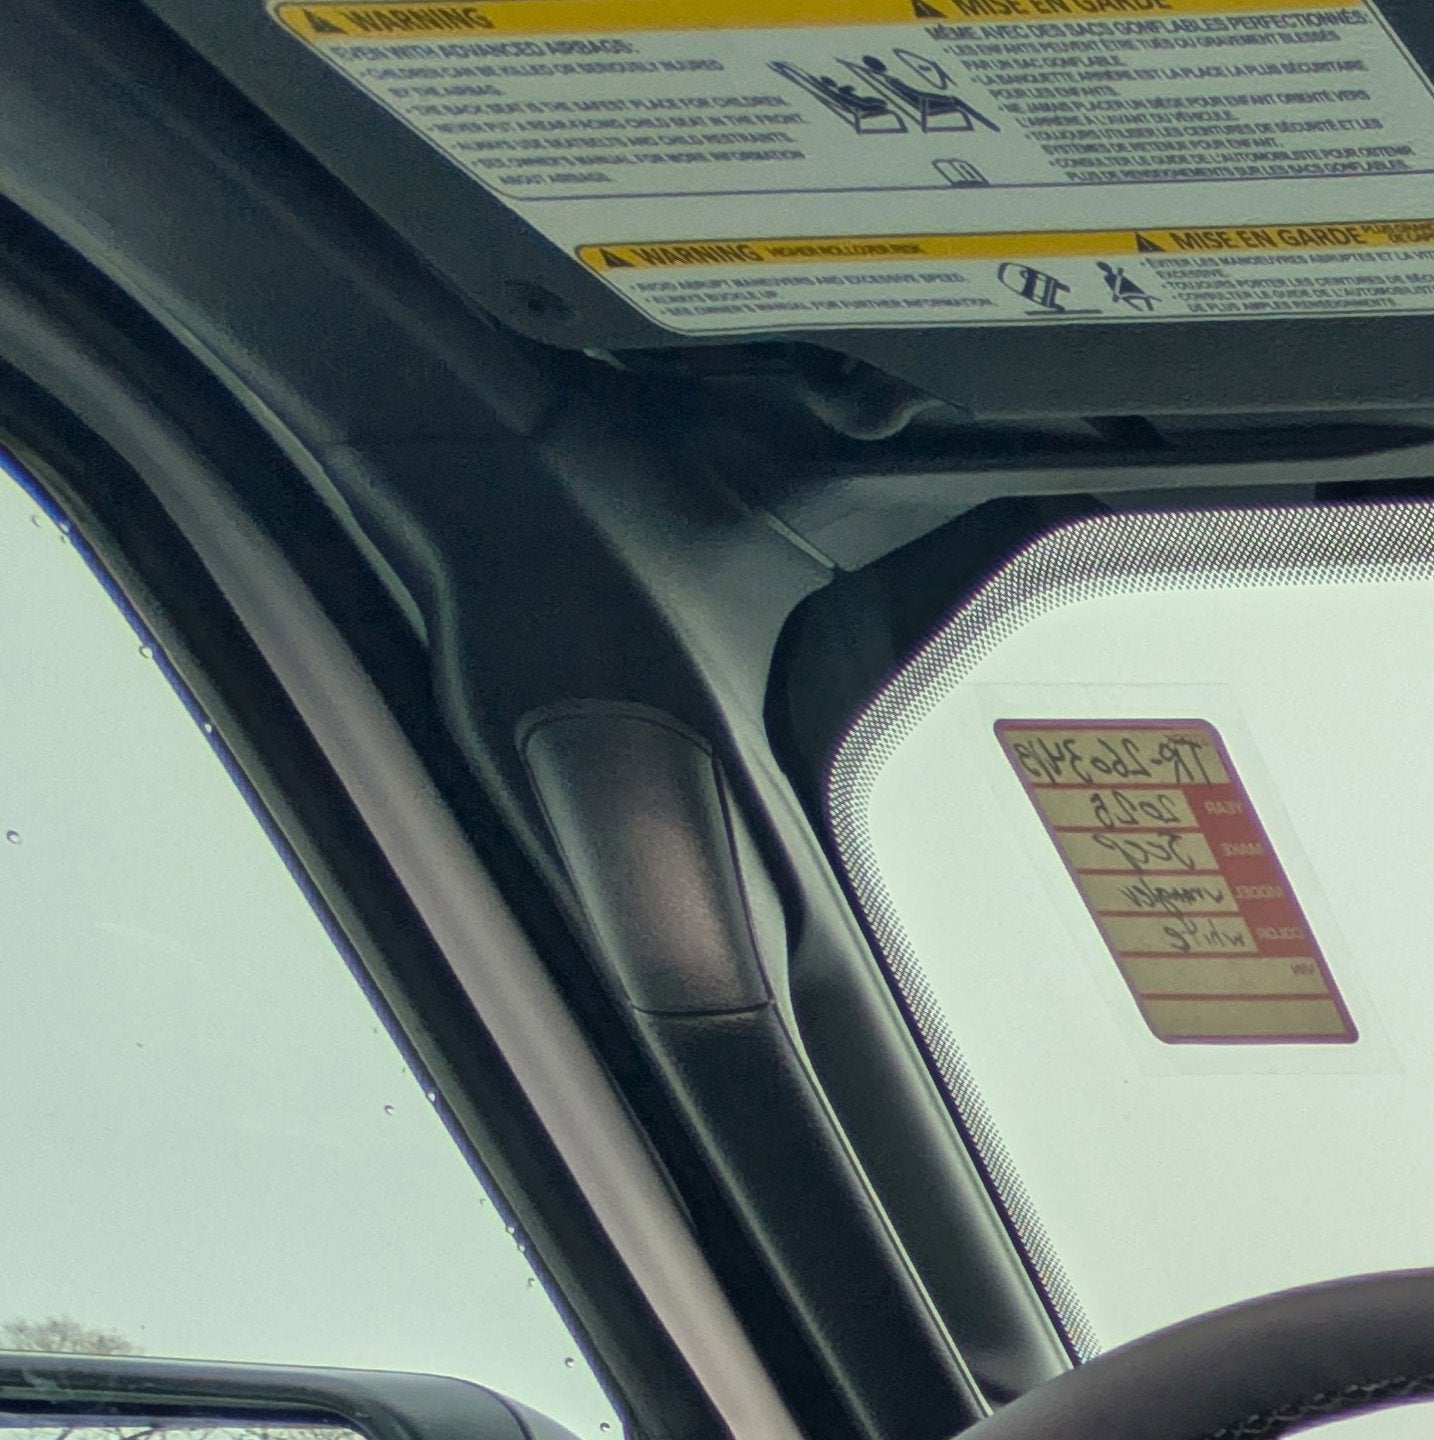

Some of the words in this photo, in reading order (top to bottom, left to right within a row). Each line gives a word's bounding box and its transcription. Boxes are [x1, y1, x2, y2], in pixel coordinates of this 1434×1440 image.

[342, 7, 495, 32] WARNING
[981, 23, 1028, 39] AVEC
[1028, 22, 1065, 38] DES
[1064, 20, 1113, 38] SACS
[1168, 229, 1244, 250] MISE
[1245, 229, 1289, 248] EN
[1289, 225, 1367, 246] GARDE
[631, 244, 765, 266] WARNING
